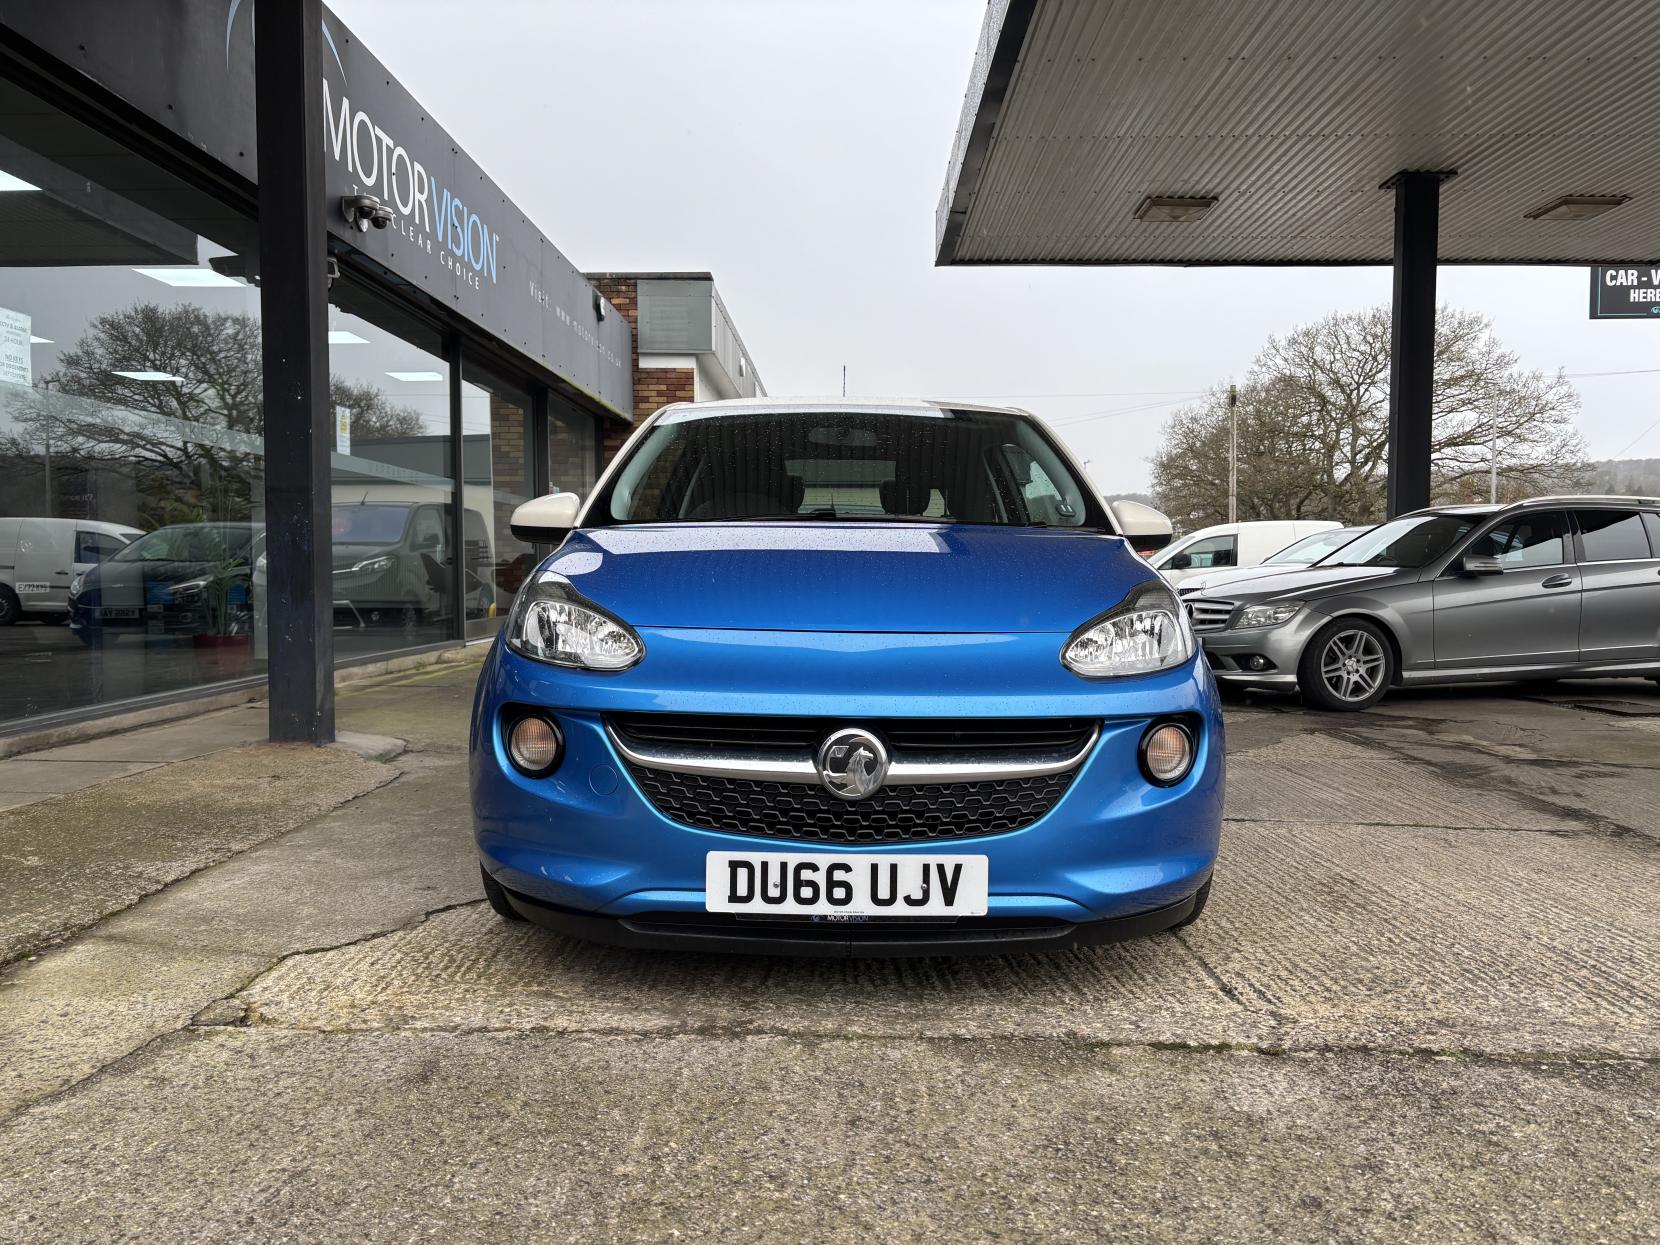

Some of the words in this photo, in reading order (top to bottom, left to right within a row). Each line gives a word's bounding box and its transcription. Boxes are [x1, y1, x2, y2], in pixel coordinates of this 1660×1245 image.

[323, 77, 497, 285] MOTORVISION
[391, 213, 432, 254] CLEAR
[440, 251, 480, 290] CHOICE
[1605, 269, 1638, 286] CAR
[728, 860, 853, 907] DU66
[870, 863, 963, 907] UJV
